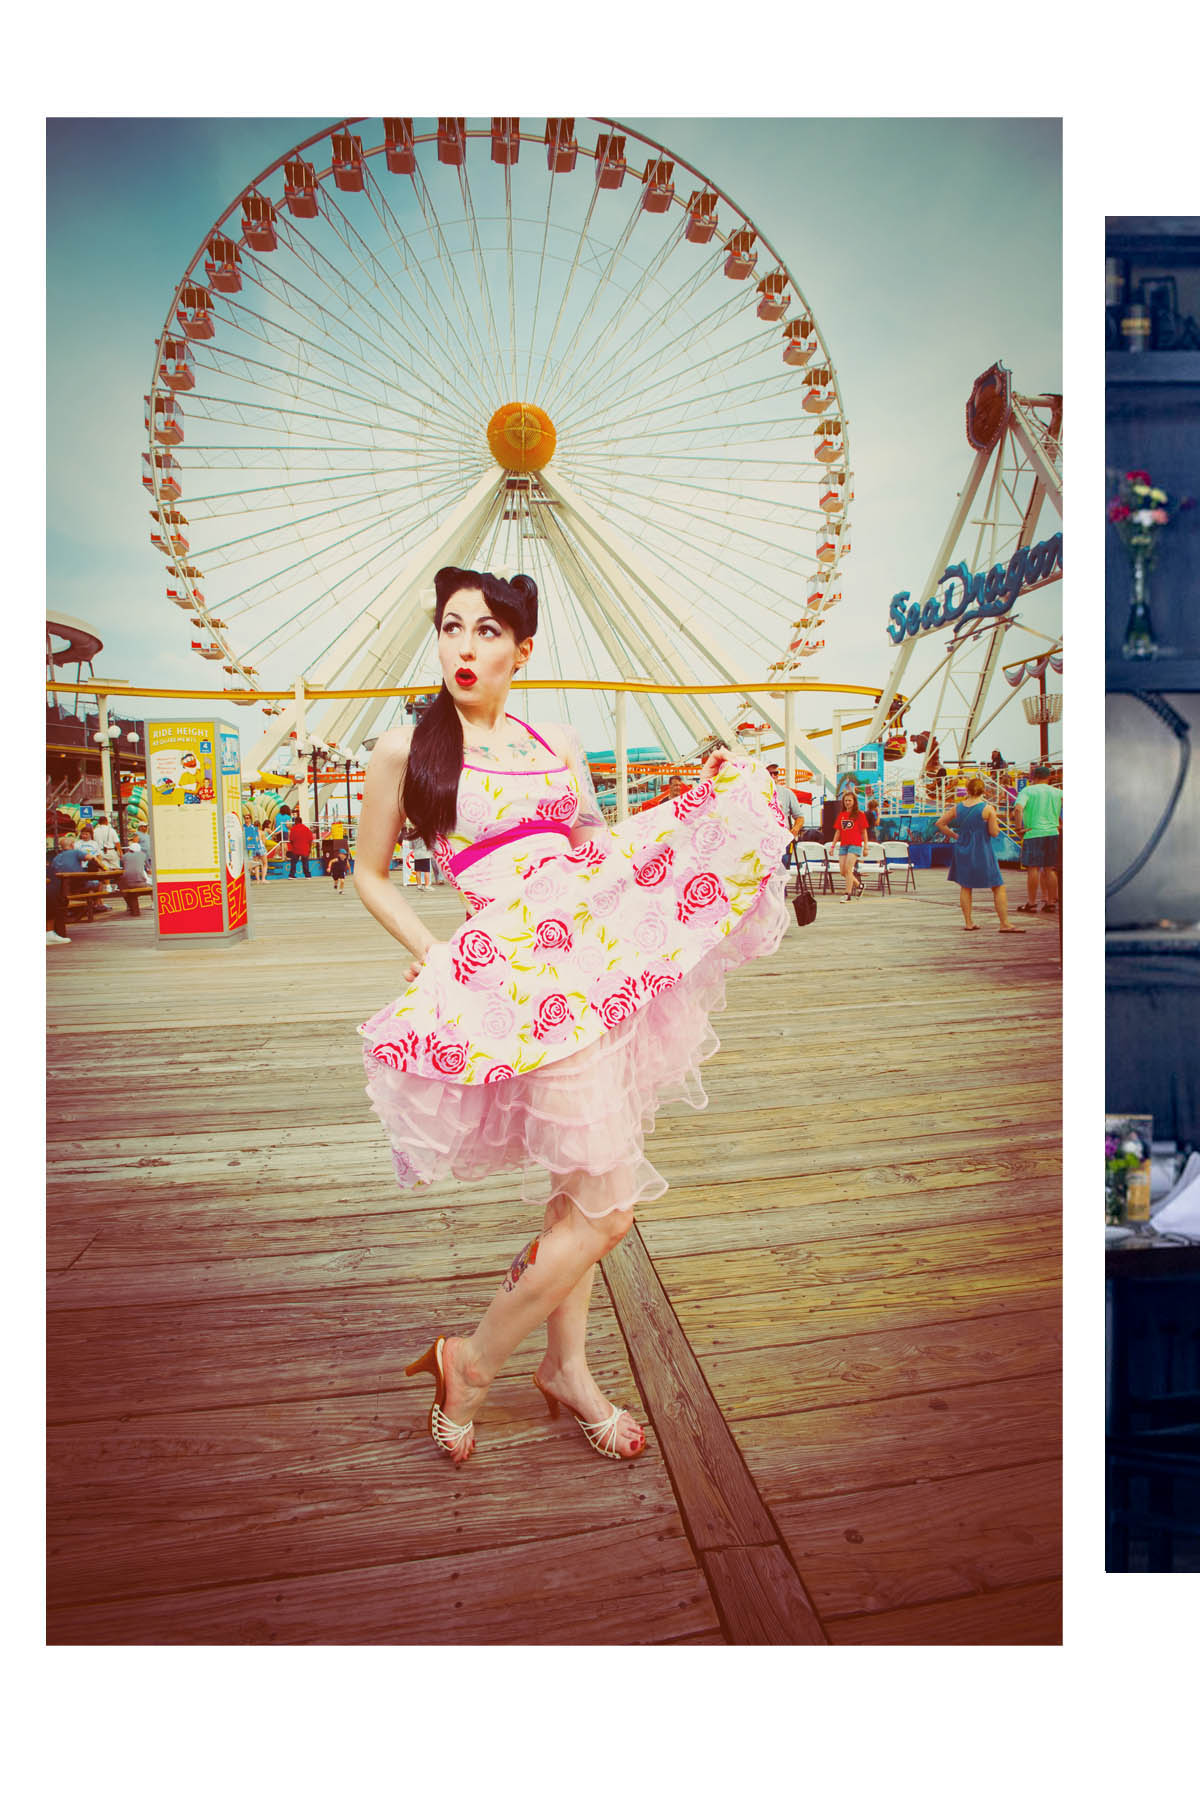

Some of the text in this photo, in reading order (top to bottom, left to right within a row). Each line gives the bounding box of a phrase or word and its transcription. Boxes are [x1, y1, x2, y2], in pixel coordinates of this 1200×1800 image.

[886, 591, 944, 645] Sea
[153, 727, 209, 739] RIDE HEIGHT
[157, 883, 222, 915] RIDES
